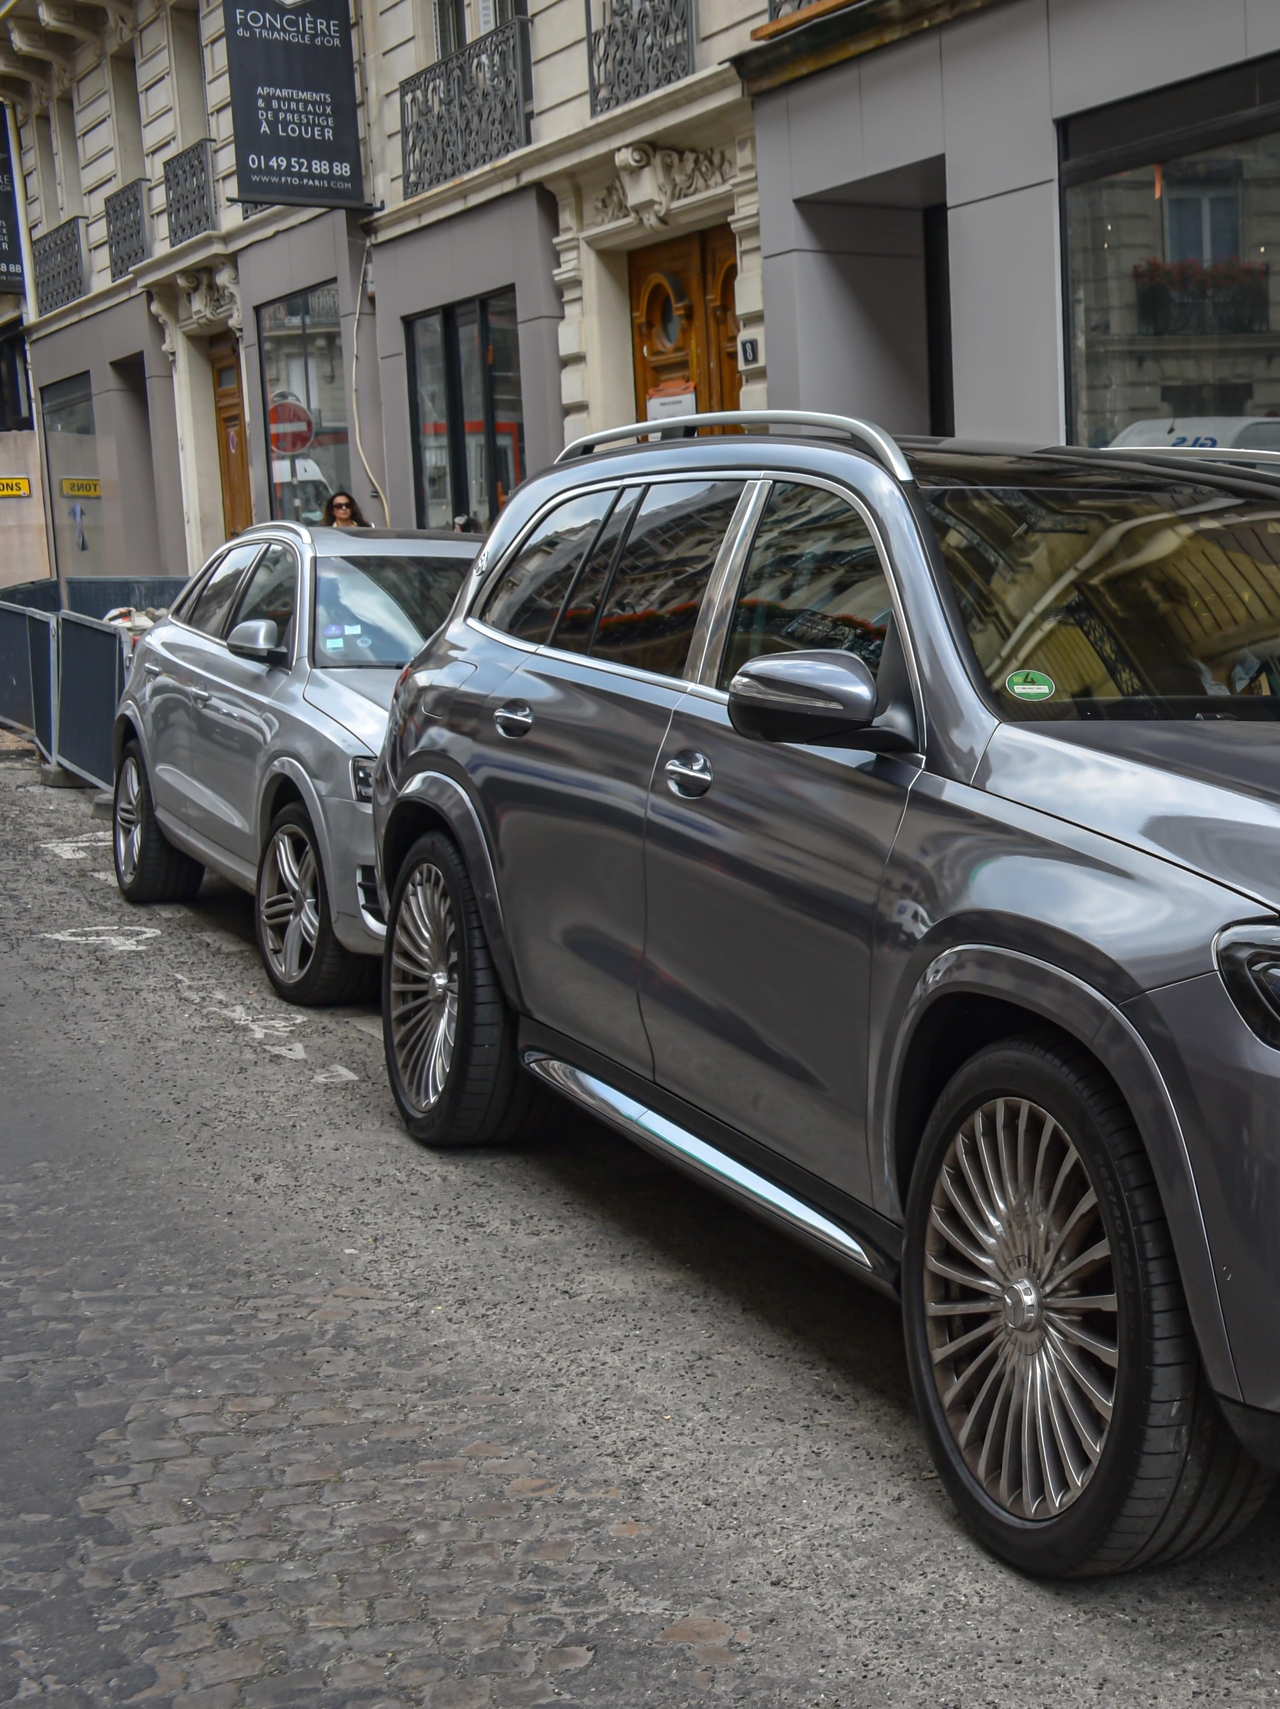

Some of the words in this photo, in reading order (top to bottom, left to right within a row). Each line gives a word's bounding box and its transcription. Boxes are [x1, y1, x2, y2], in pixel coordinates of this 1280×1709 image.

[236, 9, 340, 36] FONCIÈRE
[236, 27, 250, 37] du
[253, 28, 311, 44] TRIANGLE
[314, 36, 341, 47] d'OR
[257, 87, 331, 102] APPARTEMENTS
[257, 98, 265, 108] &
[271, 99, 332, 115] BUREAUX
[258, 110, 274, 120] DE
[278, 112, 334, 127] PRESTIGE
[260, 120, 270, 135] À
[278, 123, 333, 141] LOUER
[248, 154, 265, 170] 01
[268, 156, 287, 170] 49
[291, 157, 309, 173] 52
[311, 159, 330, 174] 88
[332, 162, 351, 177] 88
[745, 343, 753, 360] 8
[1022, 671, 1037, 686] 4
